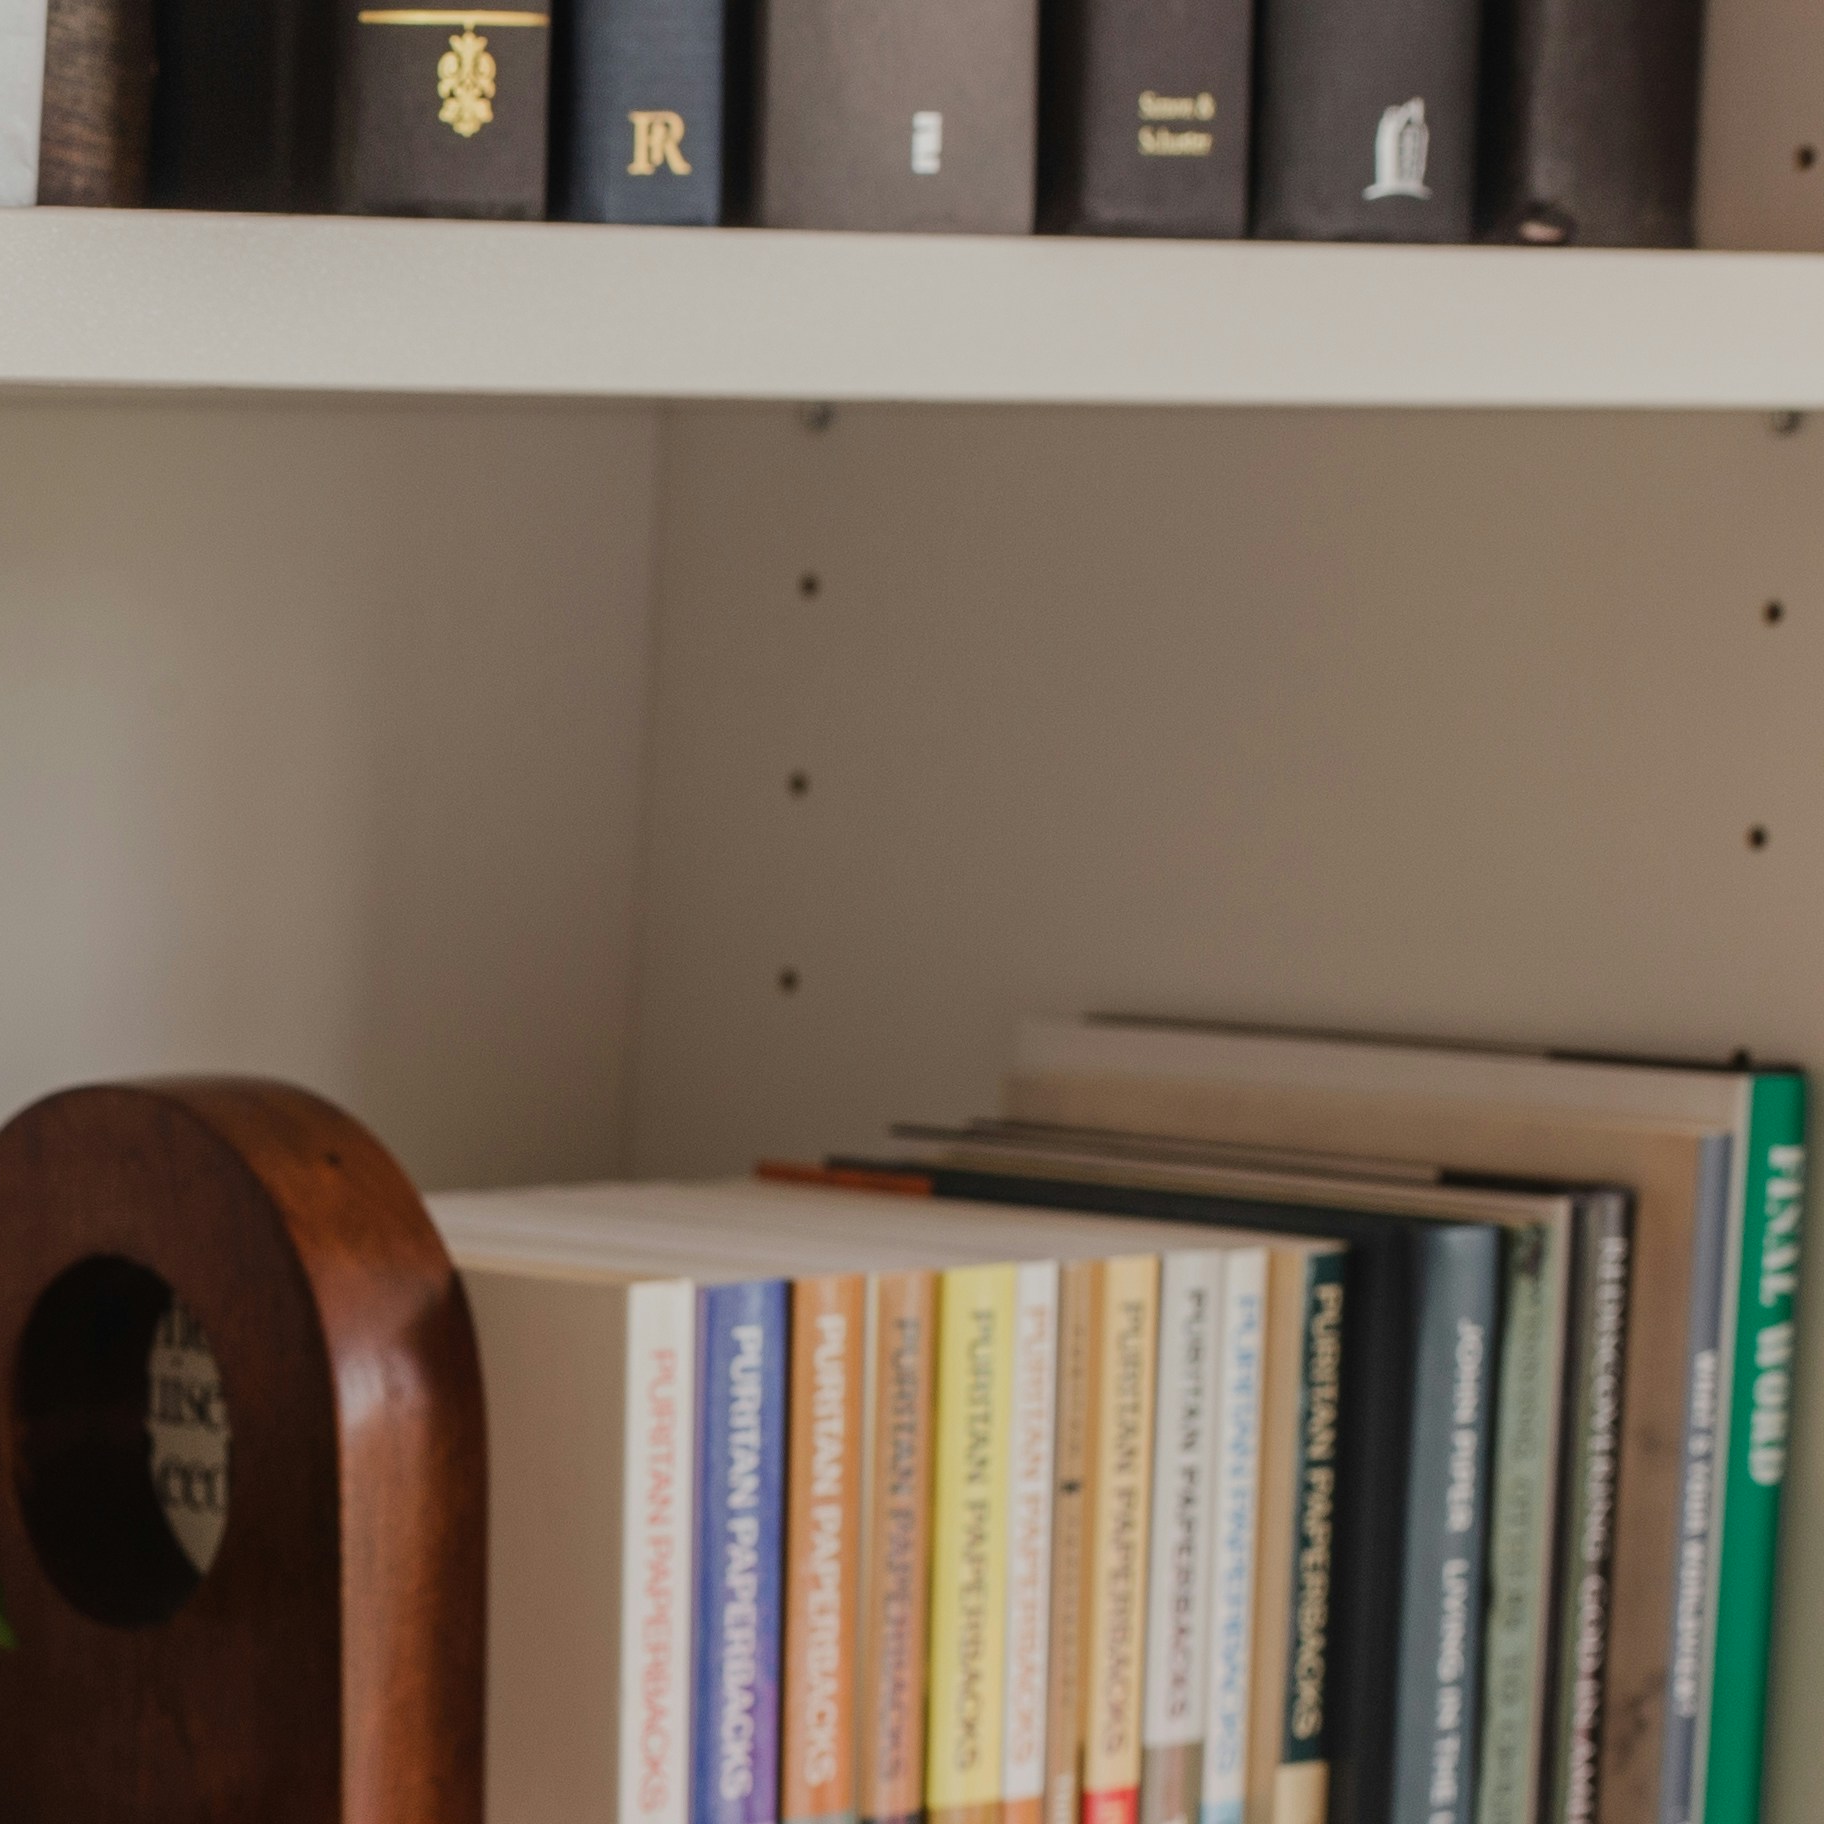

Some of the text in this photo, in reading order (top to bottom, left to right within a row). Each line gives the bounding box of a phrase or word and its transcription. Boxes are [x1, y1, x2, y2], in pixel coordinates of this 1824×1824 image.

[1446, 1318, 1484, 1533] JOHN PIPER
[1759, 1144, 1805, 1306] FINAL
[639, 1349, 677, 1813] PURITAN PAPERBACKS
[719, 1325, 762, 1799] PURITAN PAPERBACKS
[804, 1313, 847, 1786] PURITAN PAPERBACKS
[879, 1318, 920, 1783] PURITAN PAPERBACKS
[955, 1310, 996, 1771] PURITAN PAPERBACKS
[1012, 1304, 1050, 1765] PURITAN PAPERBACKS
[1101, 1300, 1147, 1758] PURITAN PAPERBACKS
[1166, 1289, 1209, 1721] PURITAN PAPERBACKS
[1292, 1283, 1345, 1739] PURITAN PAPERBACKS
[1434, 1688, 1462, 1728] IN
[1437, 1560, 1470, 1682] LIVING
[1575, 1575, 1609, 1672] GOD
[1429, 1736, 1461, 1807] THE
